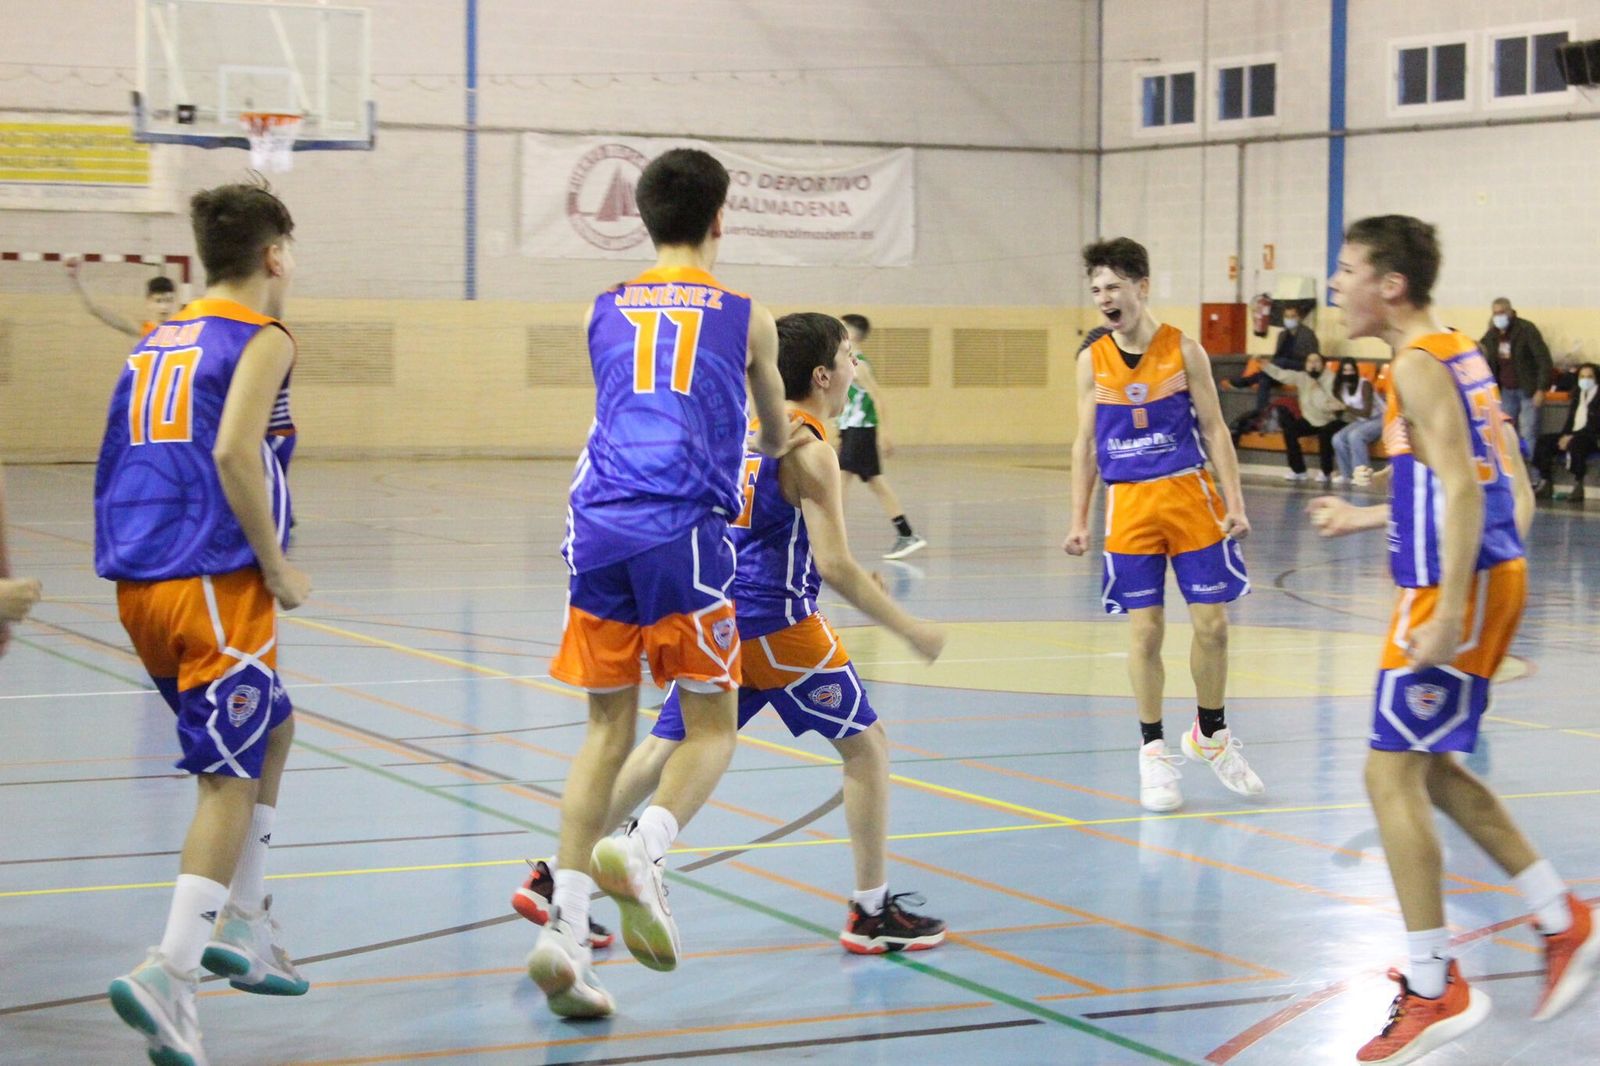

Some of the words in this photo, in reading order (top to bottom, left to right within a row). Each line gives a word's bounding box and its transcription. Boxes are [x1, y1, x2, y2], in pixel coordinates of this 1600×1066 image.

[758, 173, 871, 192] DEPORTIVO
[615, 284, 724, 310] JIMÉNEZ
[619, 307, 704, 396] 11
[127, 346, 203, 446] 10
